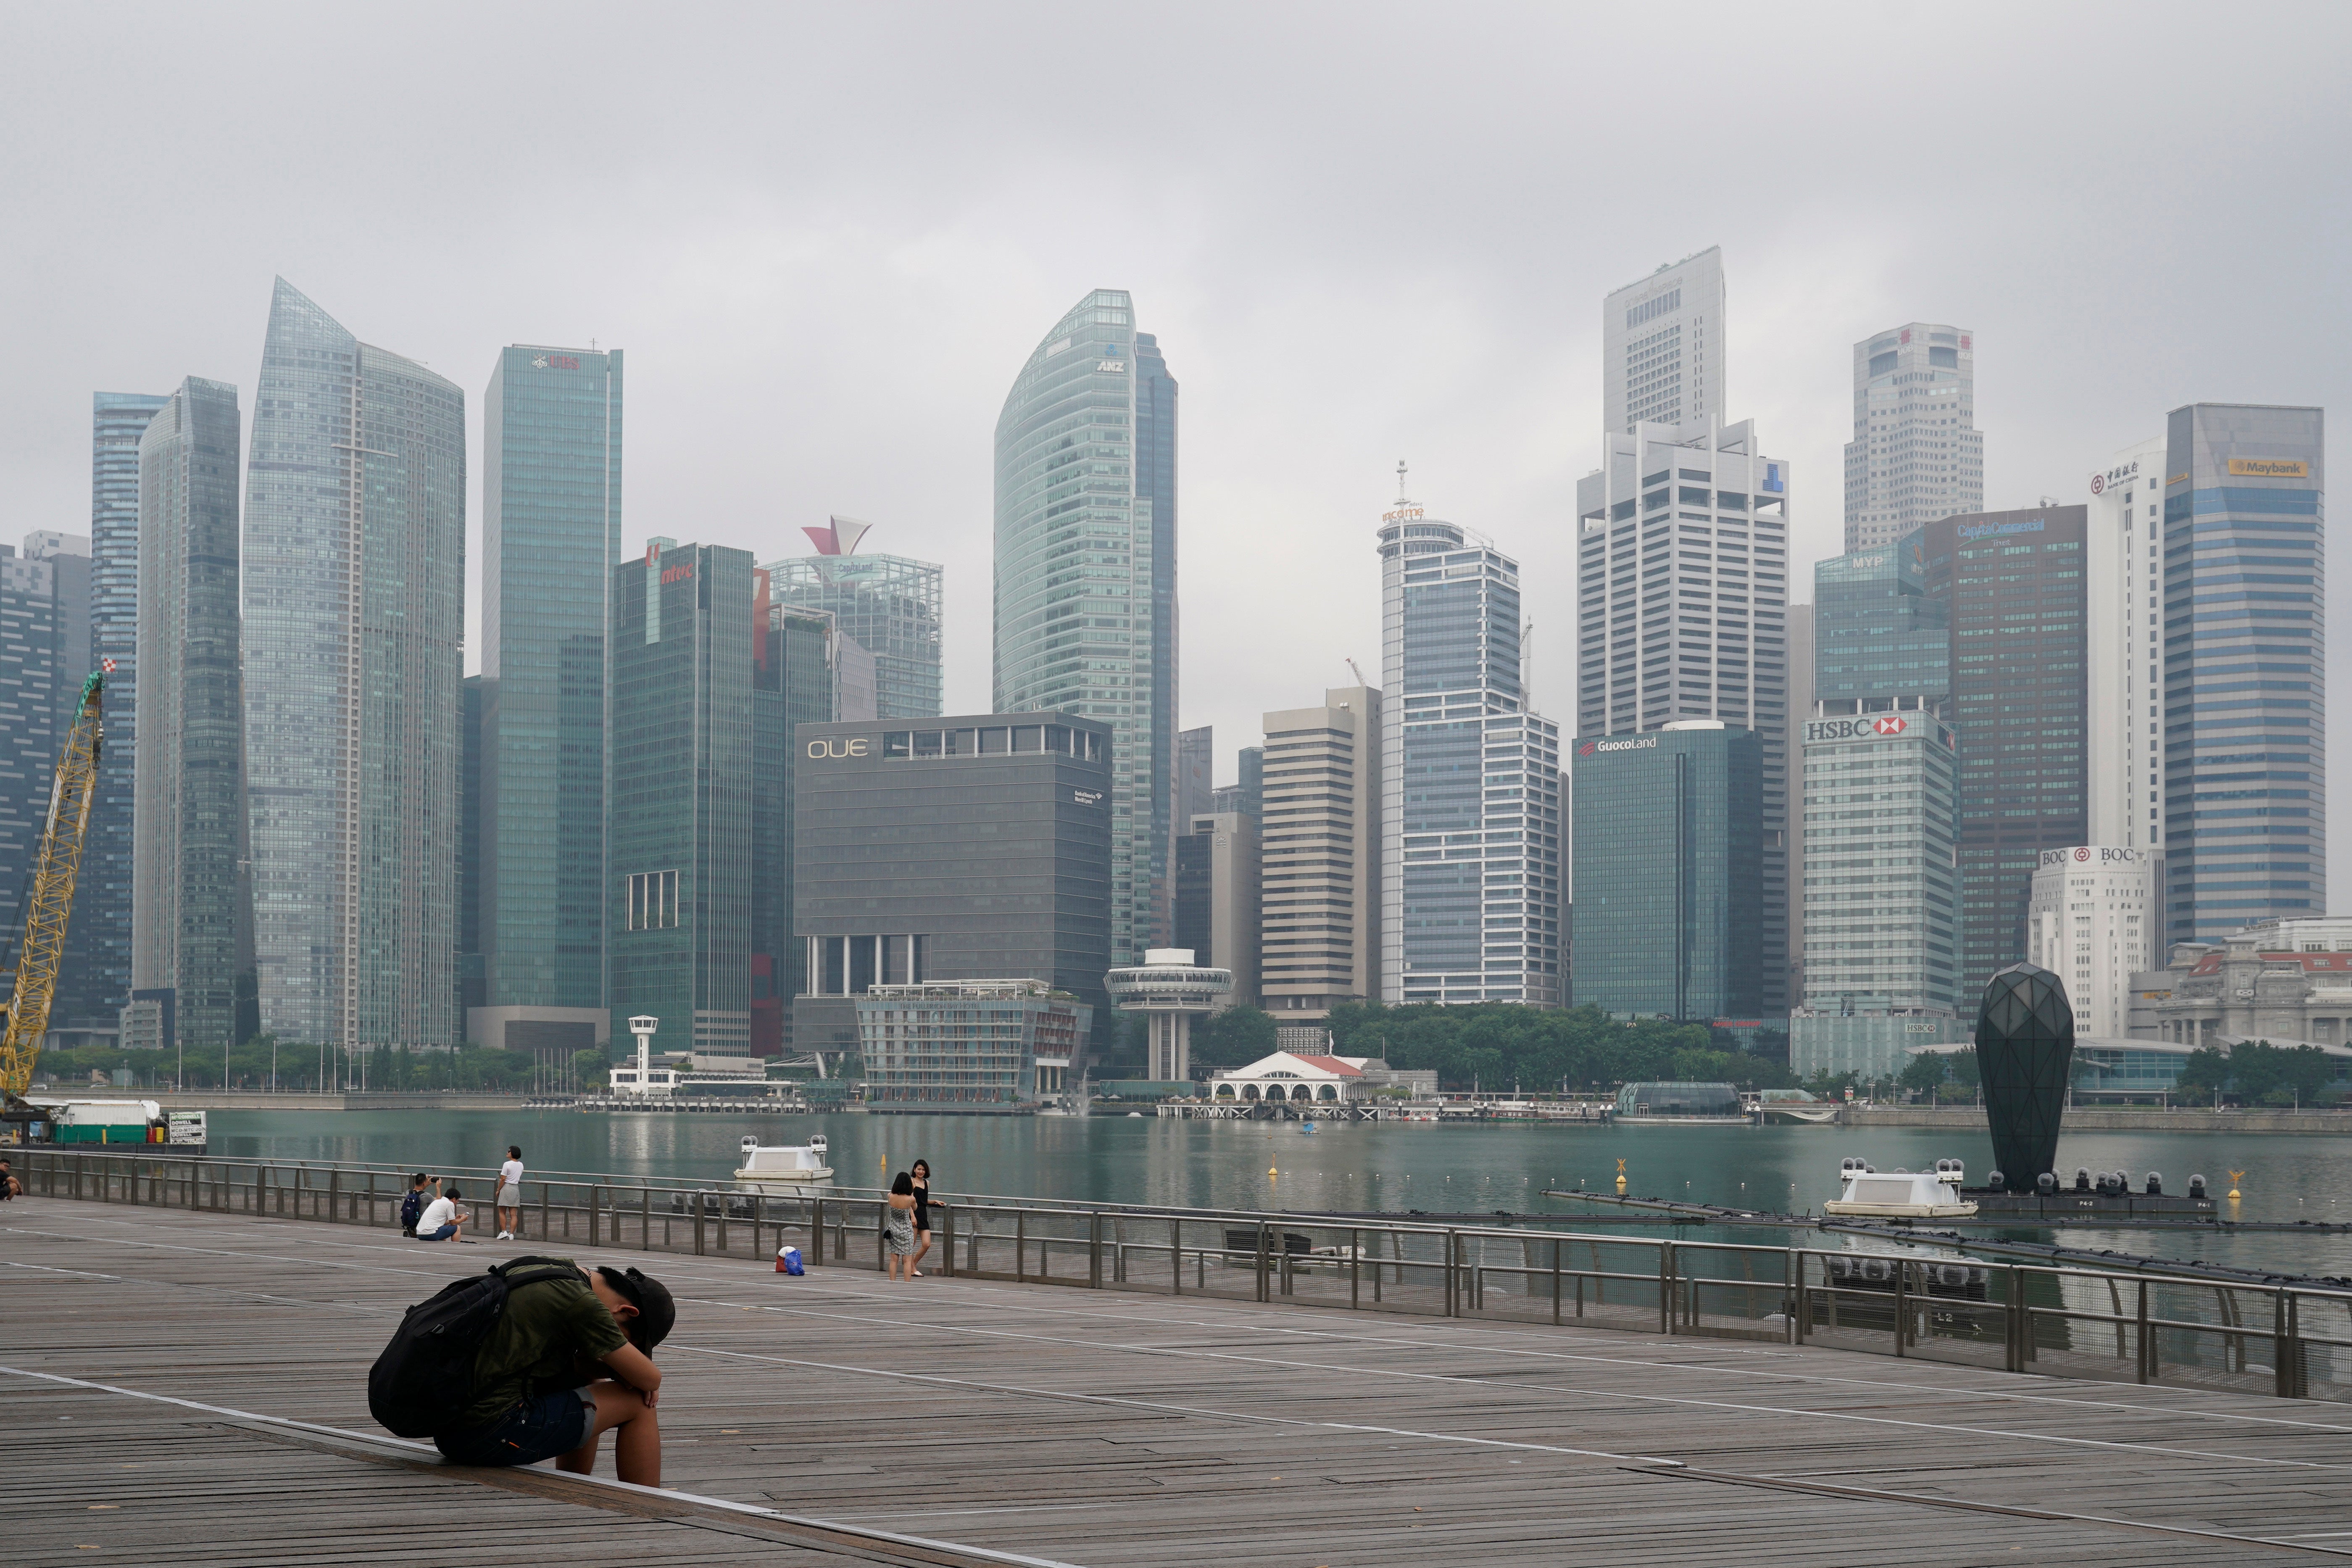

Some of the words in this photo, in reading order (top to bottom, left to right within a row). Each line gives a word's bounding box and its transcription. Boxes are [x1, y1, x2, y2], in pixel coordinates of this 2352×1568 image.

[1898, 345, 1913, 356] UOB
[1958, 351, 1973, 360] UOB
[549, 355, 579, 369] UBS
[1096, 361, 1124, 372] ANZ
[2246, 462, 2301, 474] Maybank
[2125, 475, 2139, 483] CHINA
[1382, 508, 1424, 522] income
[1957, 518, 2044, 540] CapitaCommercial
[838, 561, 873, 575] CapitaLand
[1807, 718, 1870, 741] HSBC
[808, 738, 868, 759] OUE
[1597, 737, 1656, 751] GuocoLand
[2043, 850, 2066, 865] BOC
[2101, 848, 2134, 861] BOC
